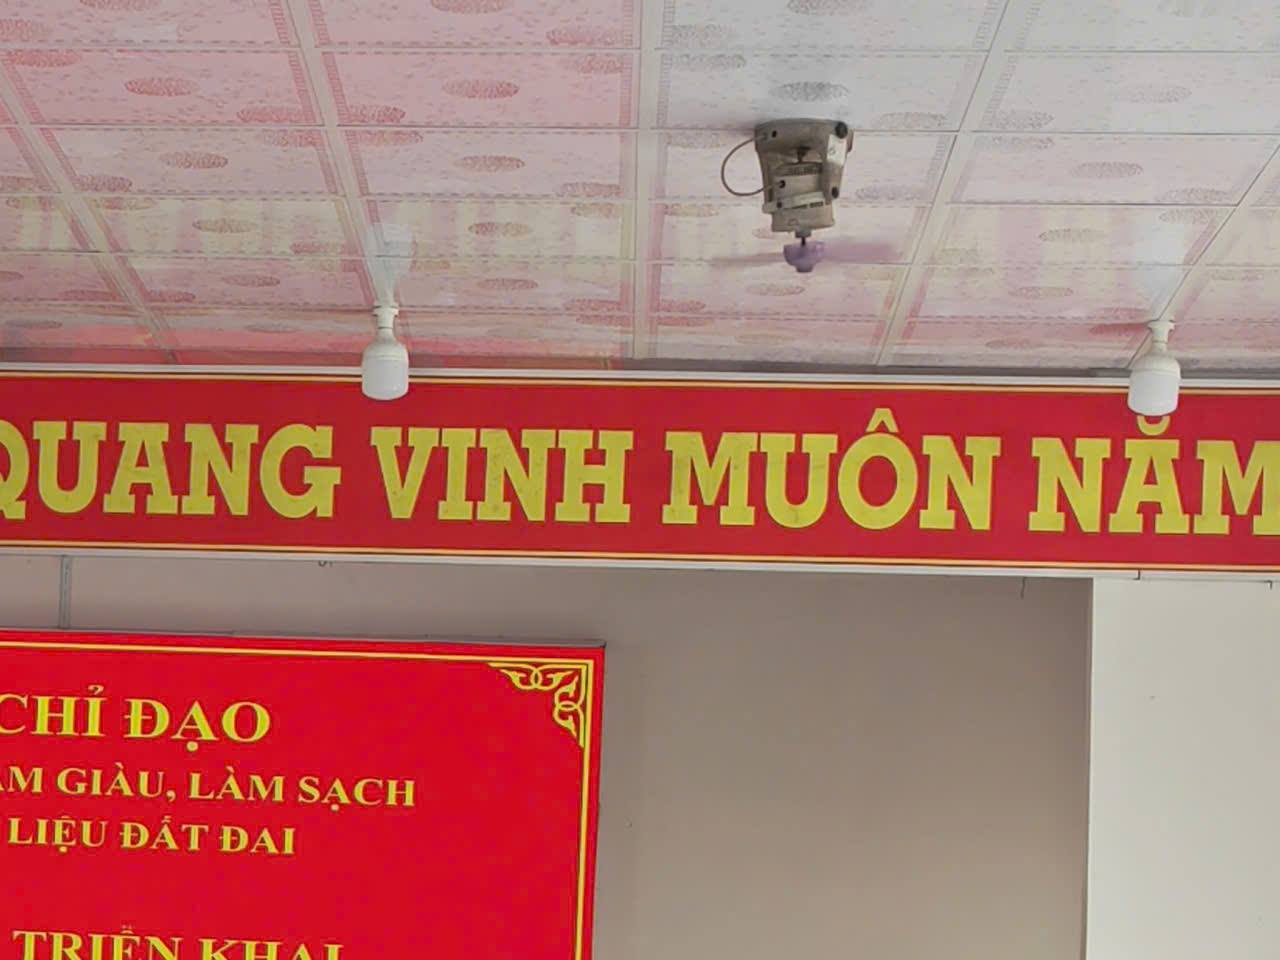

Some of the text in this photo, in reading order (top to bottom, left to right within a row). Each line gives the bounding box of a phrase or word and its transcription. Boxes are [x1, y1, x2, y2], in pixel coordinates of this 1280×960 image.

[370, 426, 634, 523] VINH
[661, 407, 1002, 531] MUÔN
[1028, 416, 1280, 536] NĂM
[124, 698, 271, 752] ĐẠO
[56, 763, 176, 803] GIÀU,
[188, 766, 286, 804] LÀM
[298, 775, 416, 811] SẠCH
[8, 814, 108, 854] LIỆU
[119, 815, 209, 852] ĐẤT
[219, 824, 296, 855] ĐAI
